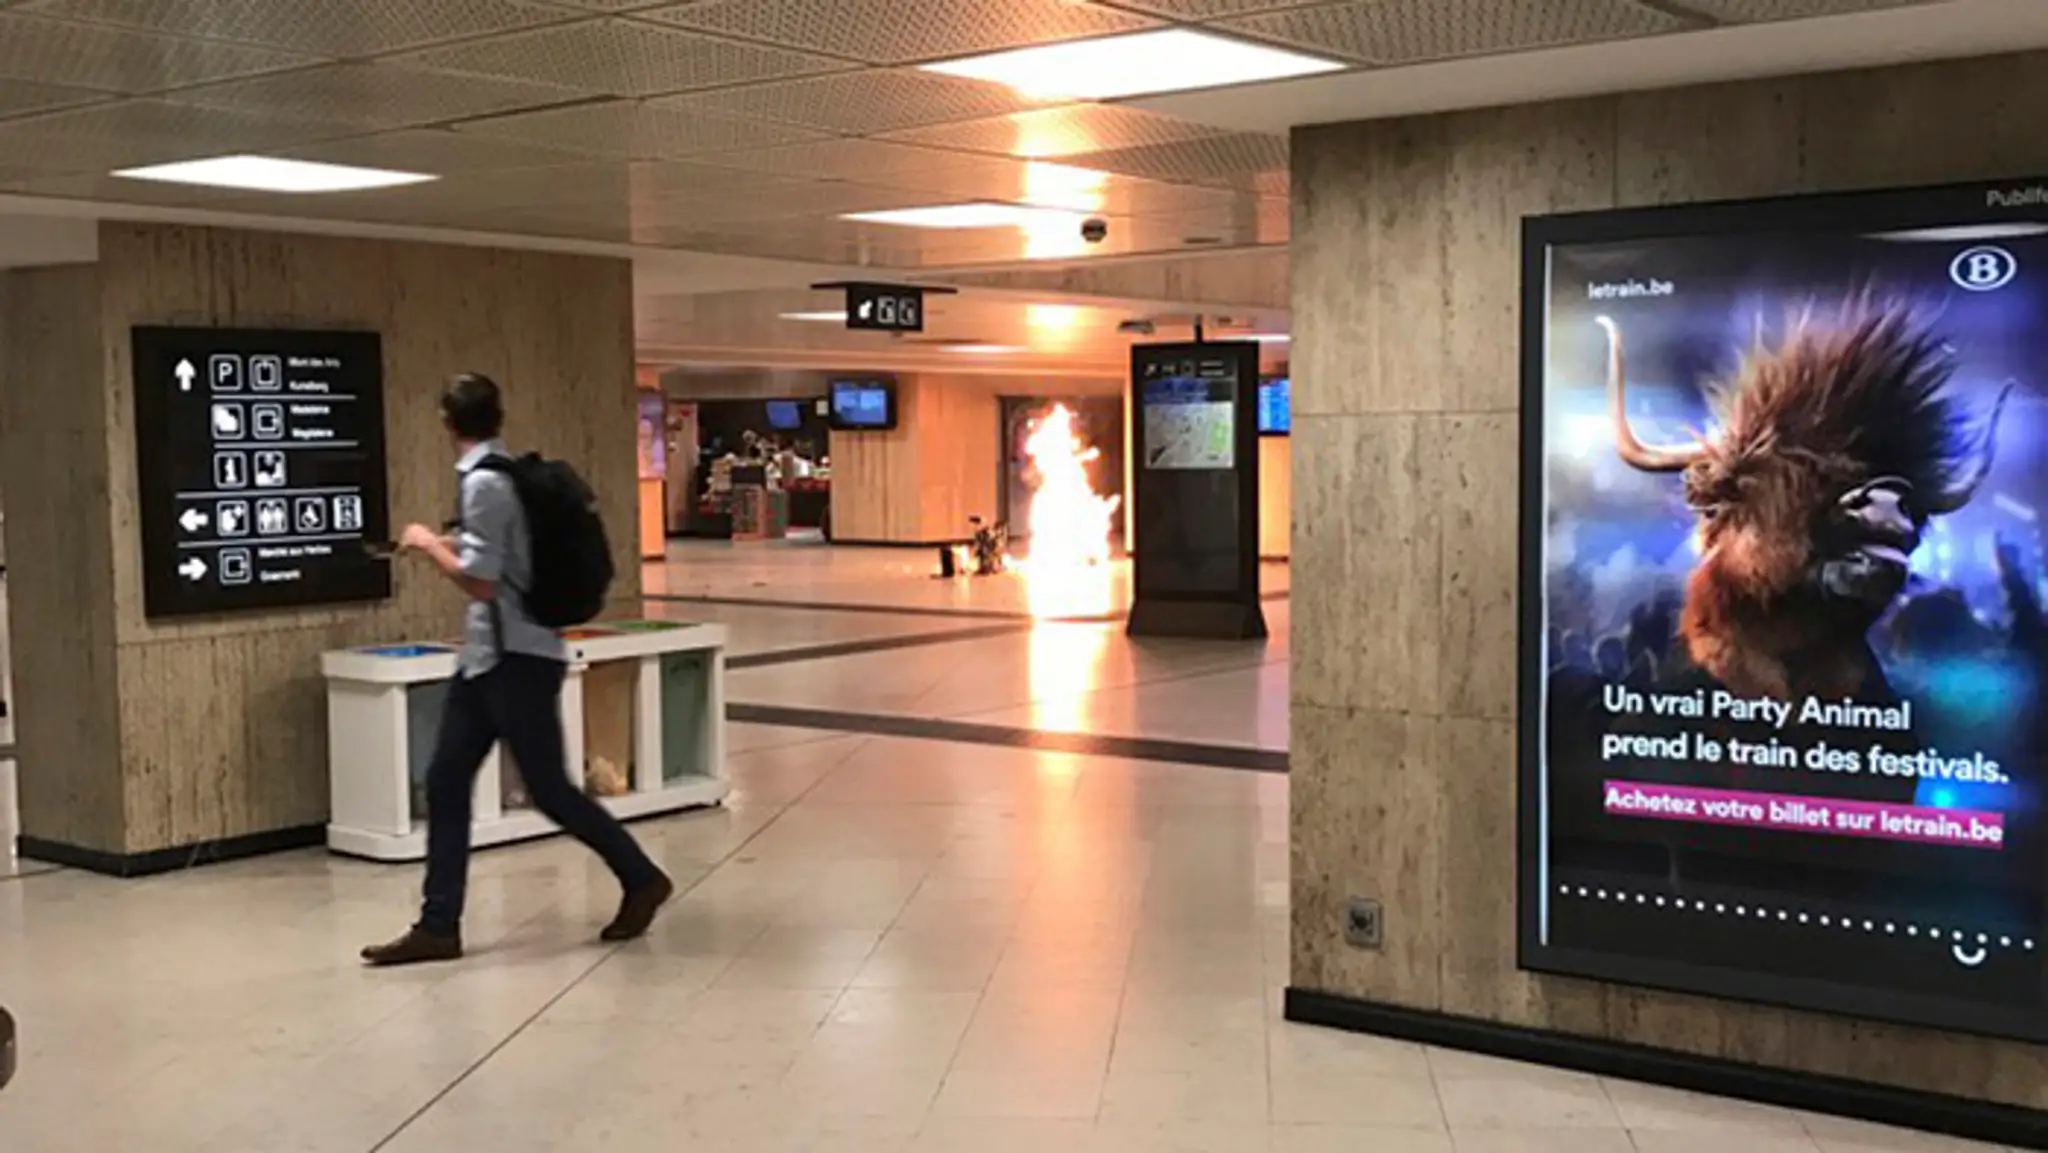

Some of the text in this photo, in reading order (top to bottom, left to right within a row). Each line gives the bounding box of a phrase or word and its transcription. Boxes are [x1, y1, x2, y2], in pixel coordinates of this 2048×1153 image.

[1968, 253, 1999, 282] B
[1588, 278, 1675, 299] letrain.be
[219, 362, 233, 383] P
[1604, 684, 1911, 730] Un vrai Party Animal
[1603, 731, 2010, 784] prend le train des festivals.
[1605, 787, 2003, 843] Achetez votre billet sur letrain.be
